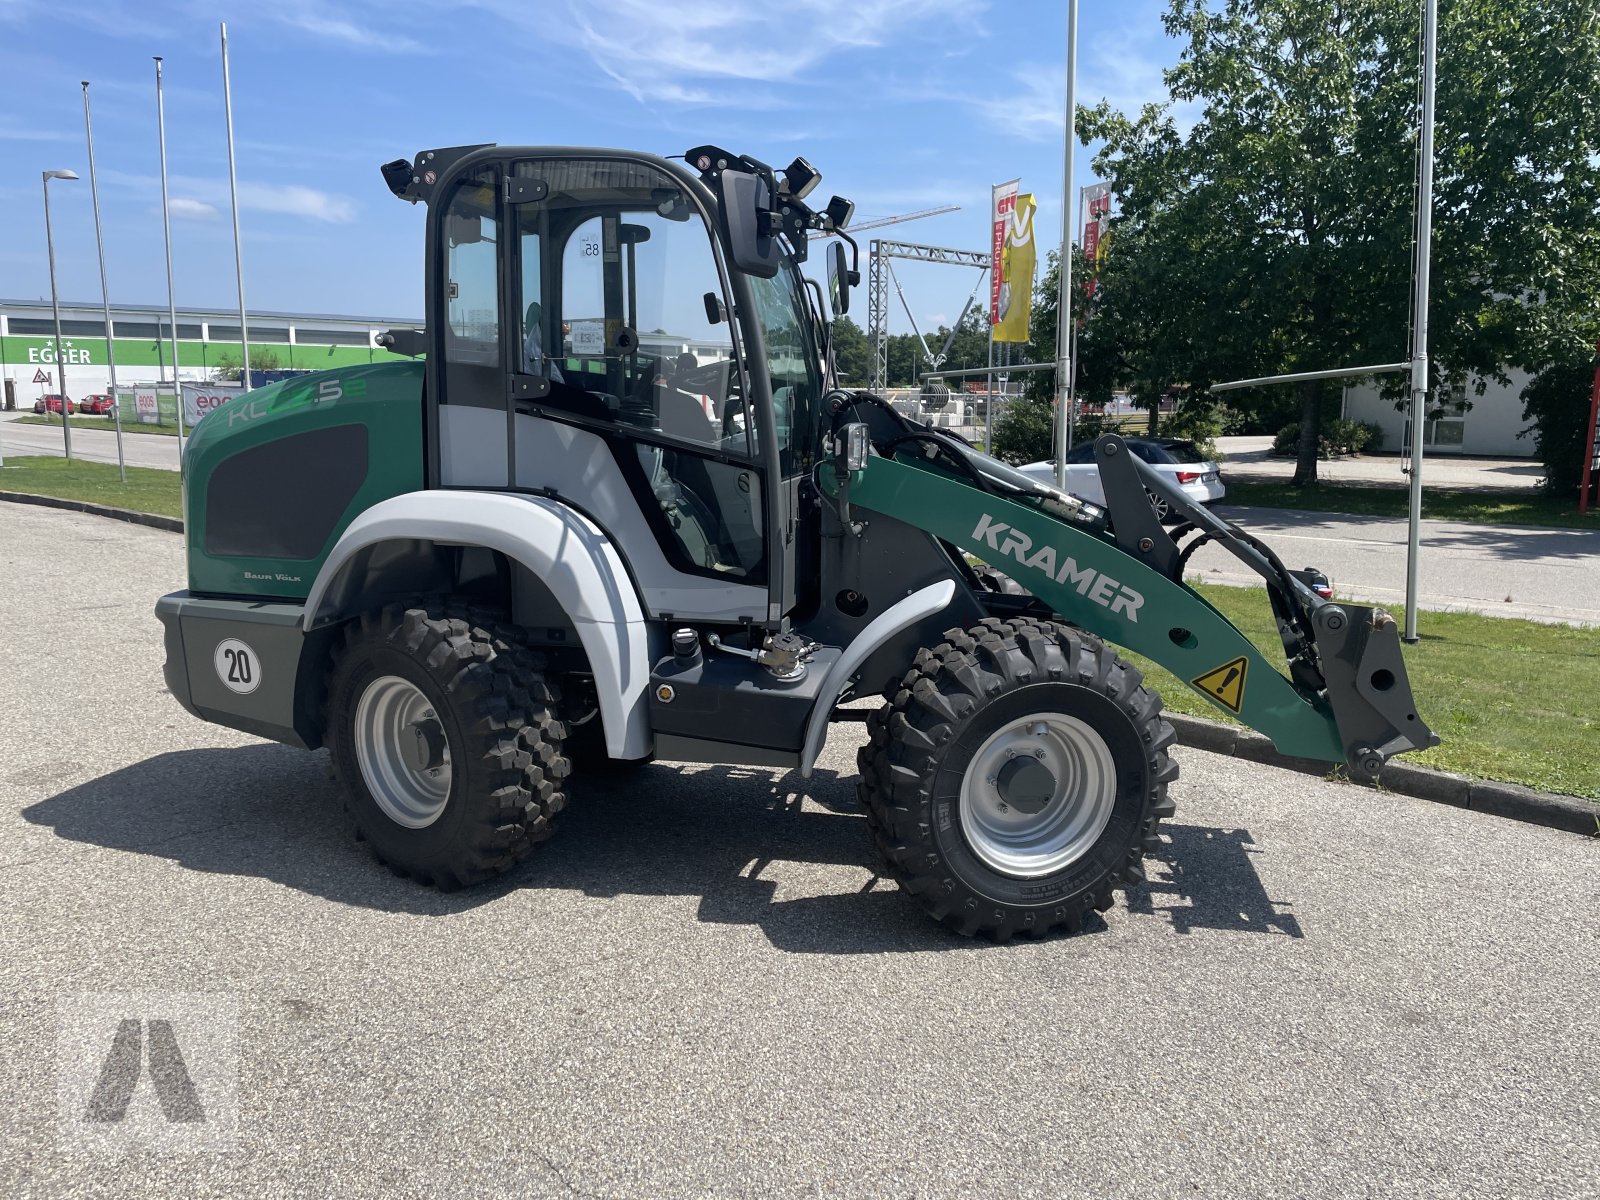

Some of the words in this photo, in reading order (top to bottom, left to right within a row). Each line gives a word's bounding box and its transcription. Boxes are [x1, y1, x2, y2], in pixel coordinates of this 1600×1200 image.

[28, 347, 91, 364] EGGER
[971, 512, 1146, 623] KRAMER
[224, 647, 252, 684] 20
